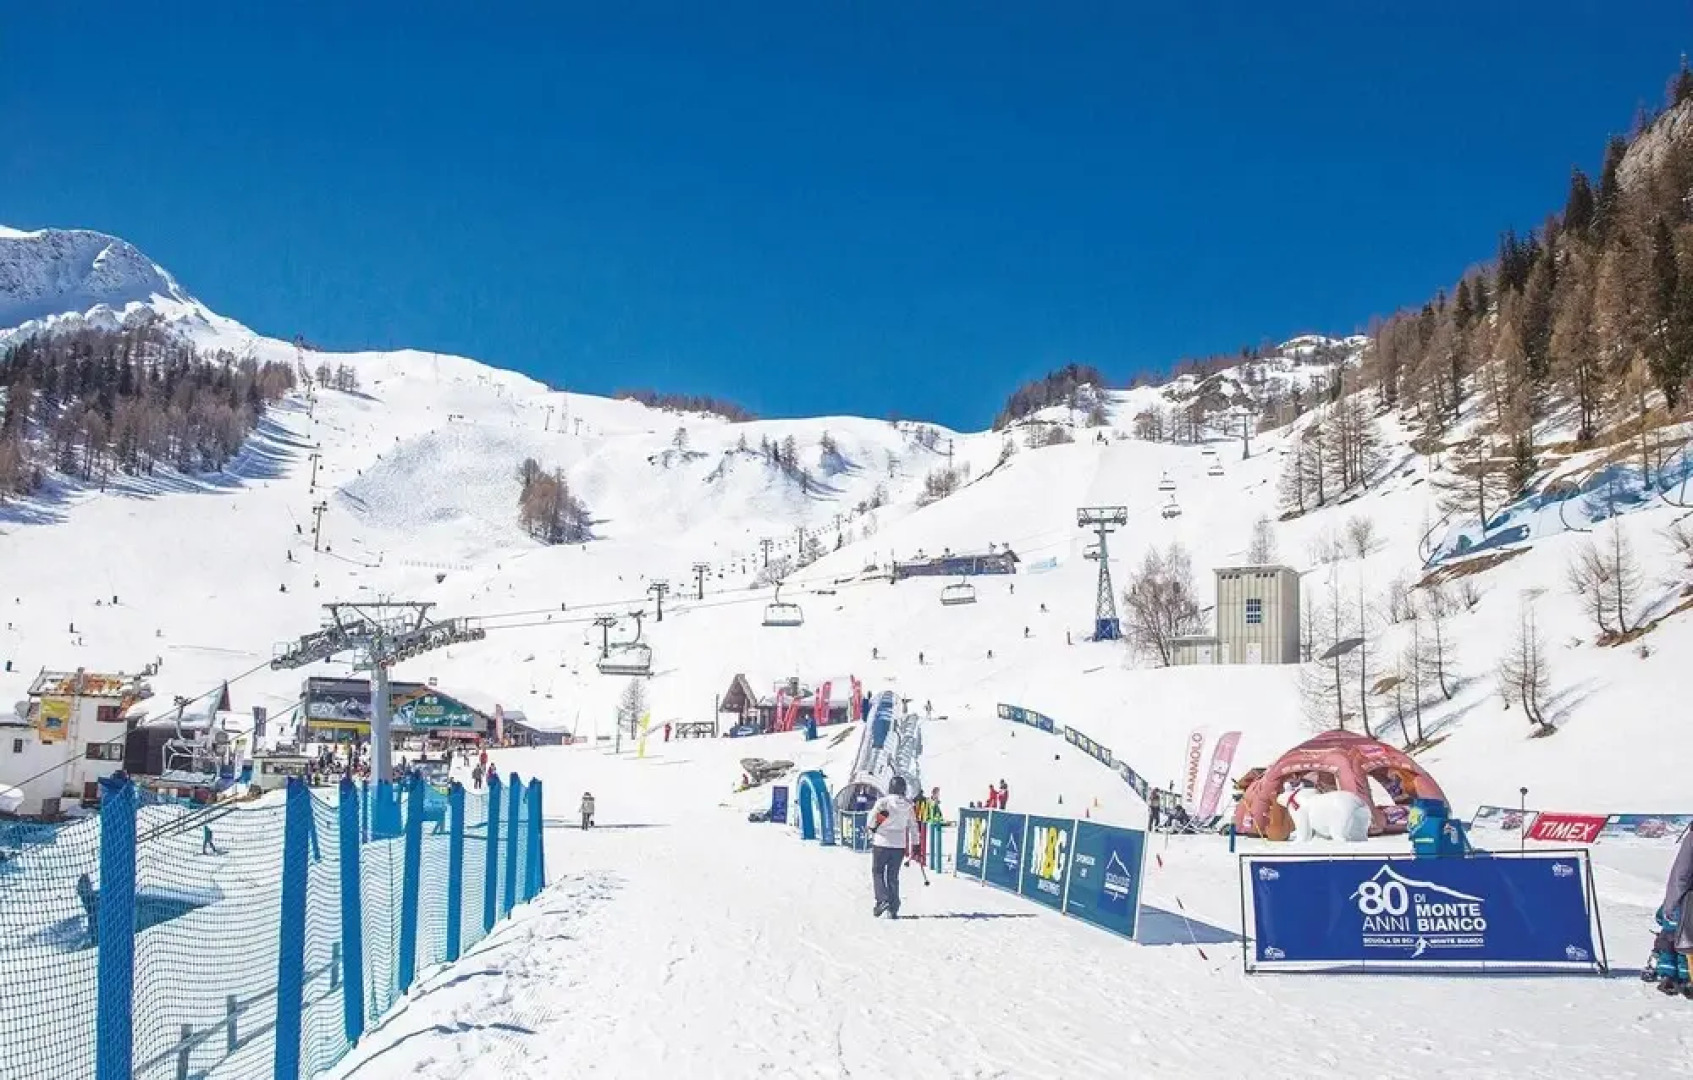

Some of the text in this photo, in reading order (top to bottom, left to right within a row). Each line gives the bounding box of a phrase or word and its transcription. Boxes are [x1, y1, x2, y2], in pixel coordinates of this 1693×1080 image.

[1538, 820, 1597, 840] TIMEX
[1358, 881, 1410, 915] 80
[1413, 893, 1426, 903] DI
[1415, 903, 1481, 917] MONTE
[1362, 915, 1410, 931] ANNI
[1416, 917, 1487, 932] BIANCO
